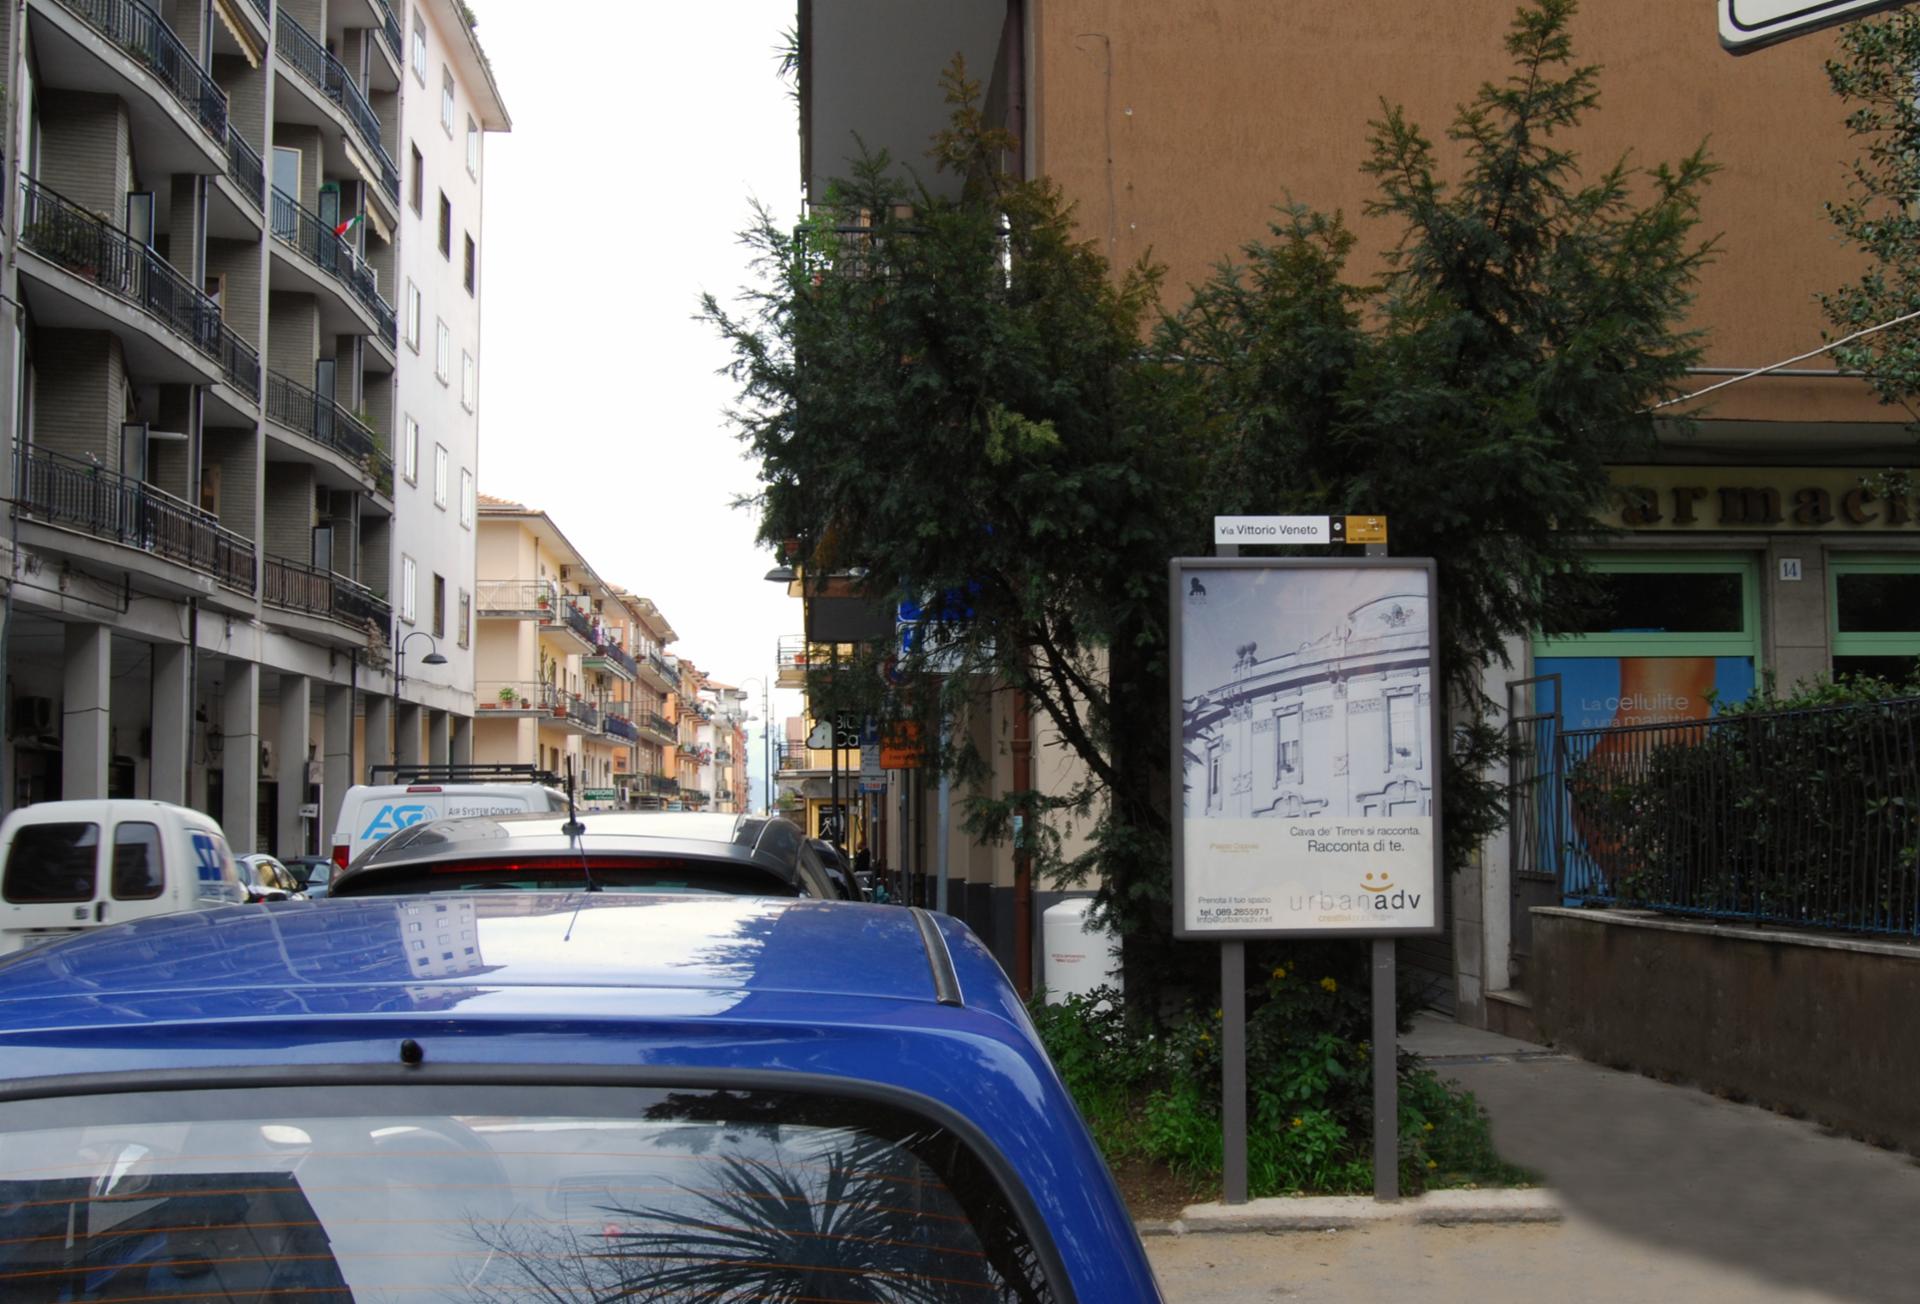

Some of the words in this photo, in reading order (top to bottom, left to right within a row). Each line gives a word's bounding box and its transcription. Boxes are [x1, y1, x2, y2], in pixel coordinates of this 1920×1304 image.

[1619, 484, 1920, 526] armaci
[1219, 526, 1235, 536] Via
[1236, 524, 1275, 536] Vittorio
[1279, 524, 1319, 536] Veneto
[1782, 561, 1799, 578] 14
[1581, 697, 1602, 712] La
[1289, 826, 1316, 837] Cava
[1336, 825, 1365, 837] Tirreni
[1366, 825, 1376, 836] si
[1377, 825, 1420, 836] racconta.
[1307, 839, 1370, 853] Racconta
[1373, 839, 1385, 852] di
[1388, 840, 1405, 852] te.
[1199, 908, 1214, 917] tel.
